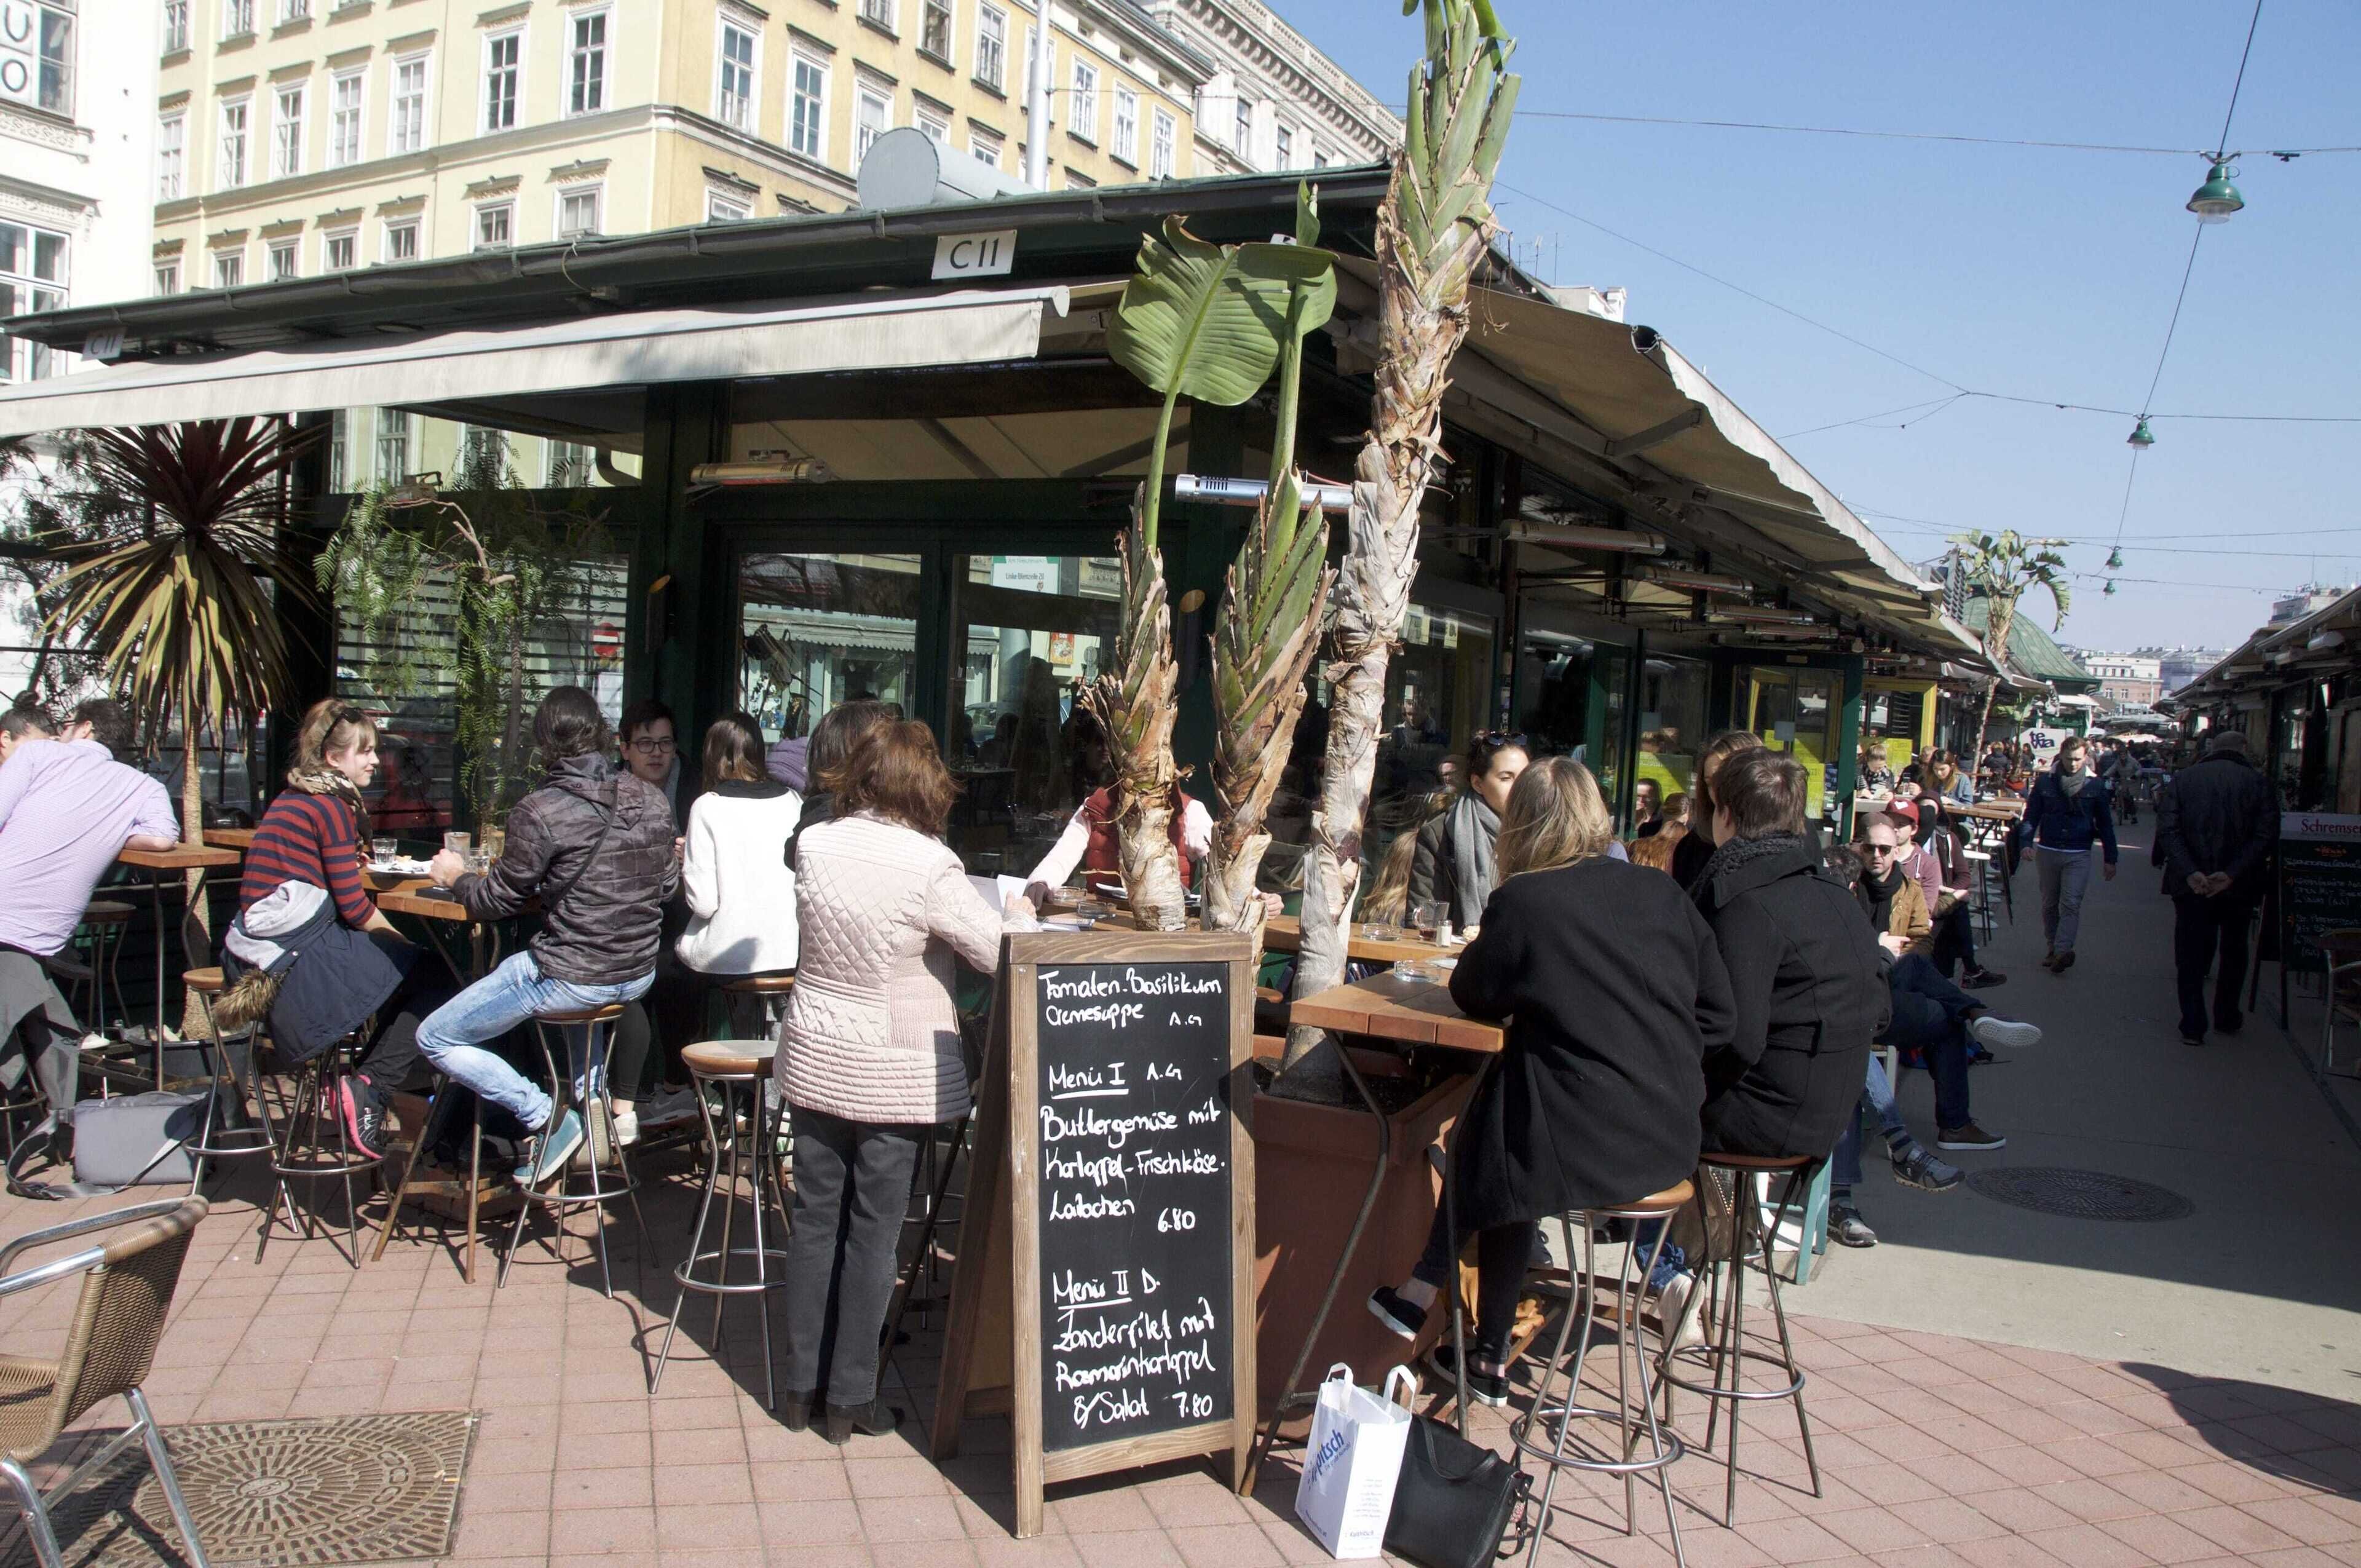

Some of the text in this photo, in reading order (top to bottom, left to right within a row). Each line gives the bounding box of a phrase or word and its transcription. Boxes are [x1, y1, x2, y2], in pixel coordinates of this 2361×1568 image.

[951, 238, 999, 269] C11
[2301, 818, 2361, 834] Schremse
[1049, 1063, 1104, 1091] Menü
[1040, 1096, 1221, 1149] Buttergemüse mit
[1053, 1269, 1107, 1304] Menü
[1052, 1296, 1215, 1353] Zanderfilet mit
[1098, 1387, 1150, 1424] Salat
